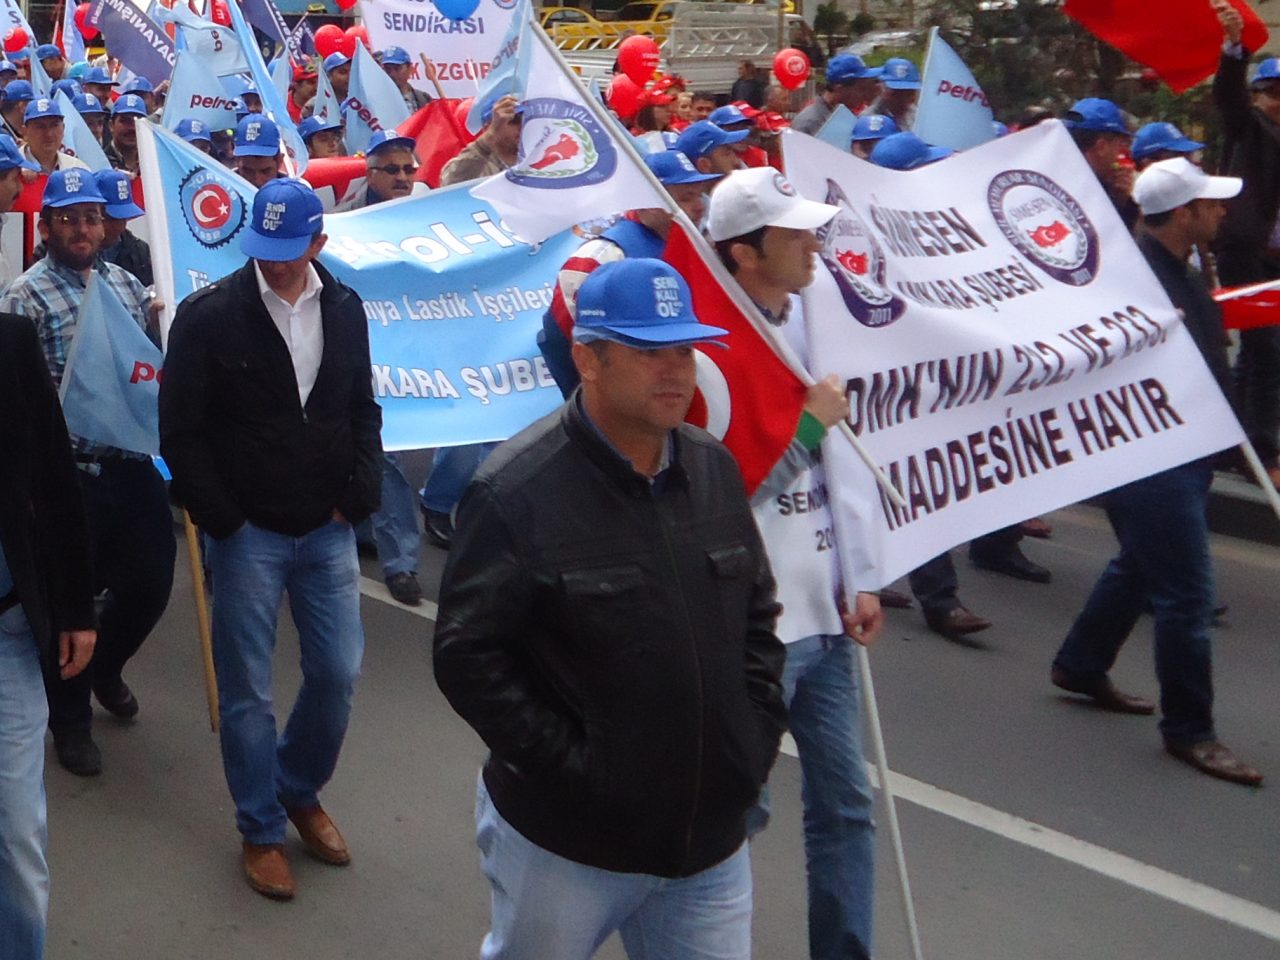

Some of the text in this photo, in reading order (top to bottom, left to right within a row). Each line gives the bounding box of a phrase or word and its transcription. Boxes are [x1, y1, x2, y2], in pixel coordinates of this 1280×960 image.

[402, 292, 473, 321] Lastik
[372, 356, 558, 405] KARA ŞUBE
[877, 377, 1186, 531] MADDESİNE HAYIR
